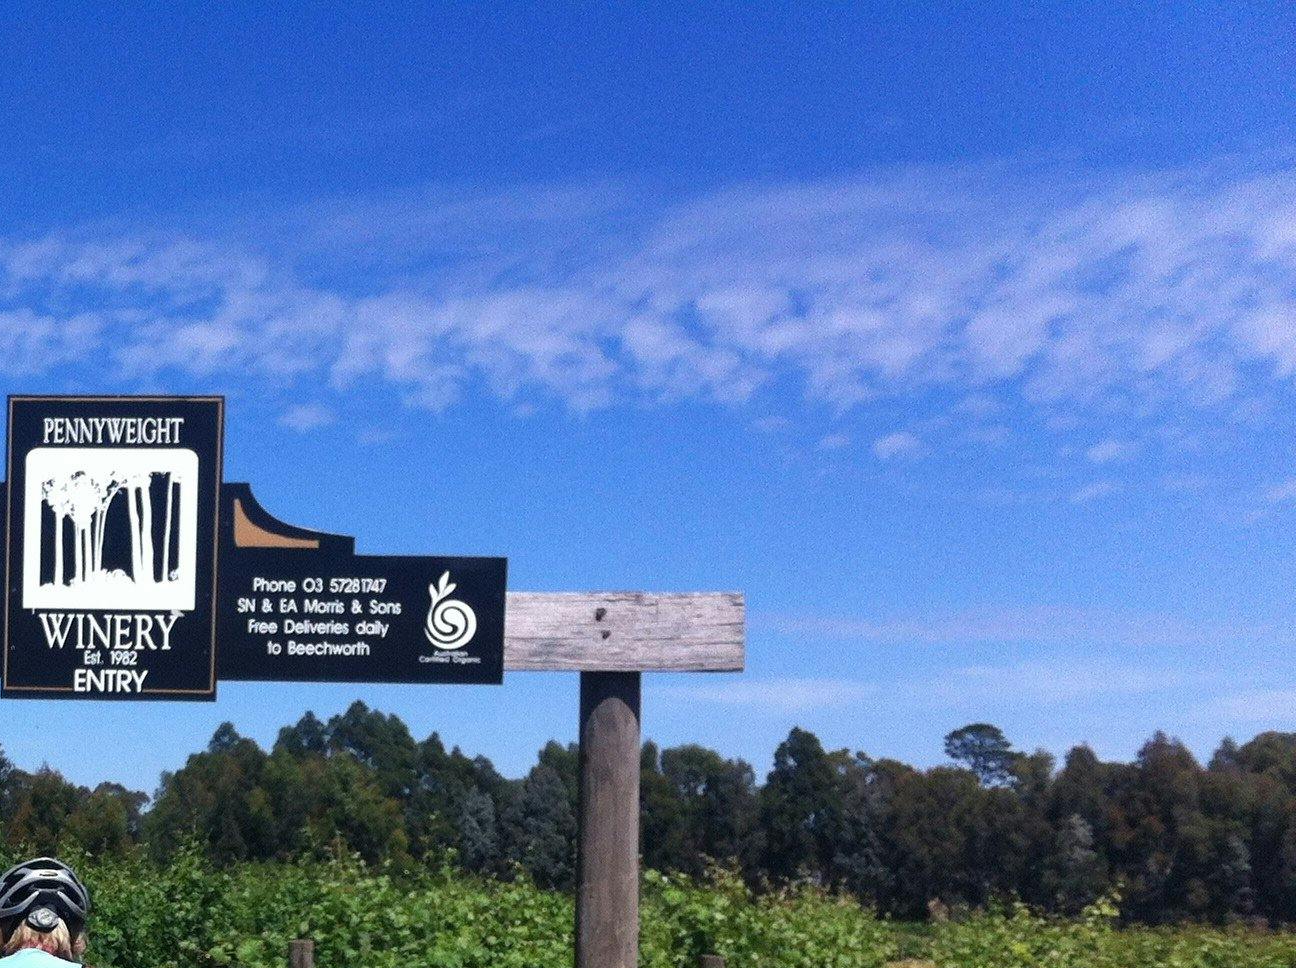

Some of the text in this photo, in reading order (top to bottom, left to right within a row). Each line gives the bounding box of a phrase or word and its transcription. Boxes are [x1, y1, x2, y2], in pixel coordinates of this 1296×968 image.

[43, 418, 184, 444] PENNYWEIGHT
[253, 577, 387, 593] Phone 03 57281747
[238, 598, 401, 615] SN & EA Morris & Sons
[39, 613, 181, 650] WINERY
[248, 619, 389, 637] Free Deliveries daily
[267, 640, 370, 655] to Beechworth
[84, 649, 137, 665] Est. 1982
[74, 669, 150, 692] ENTRY
